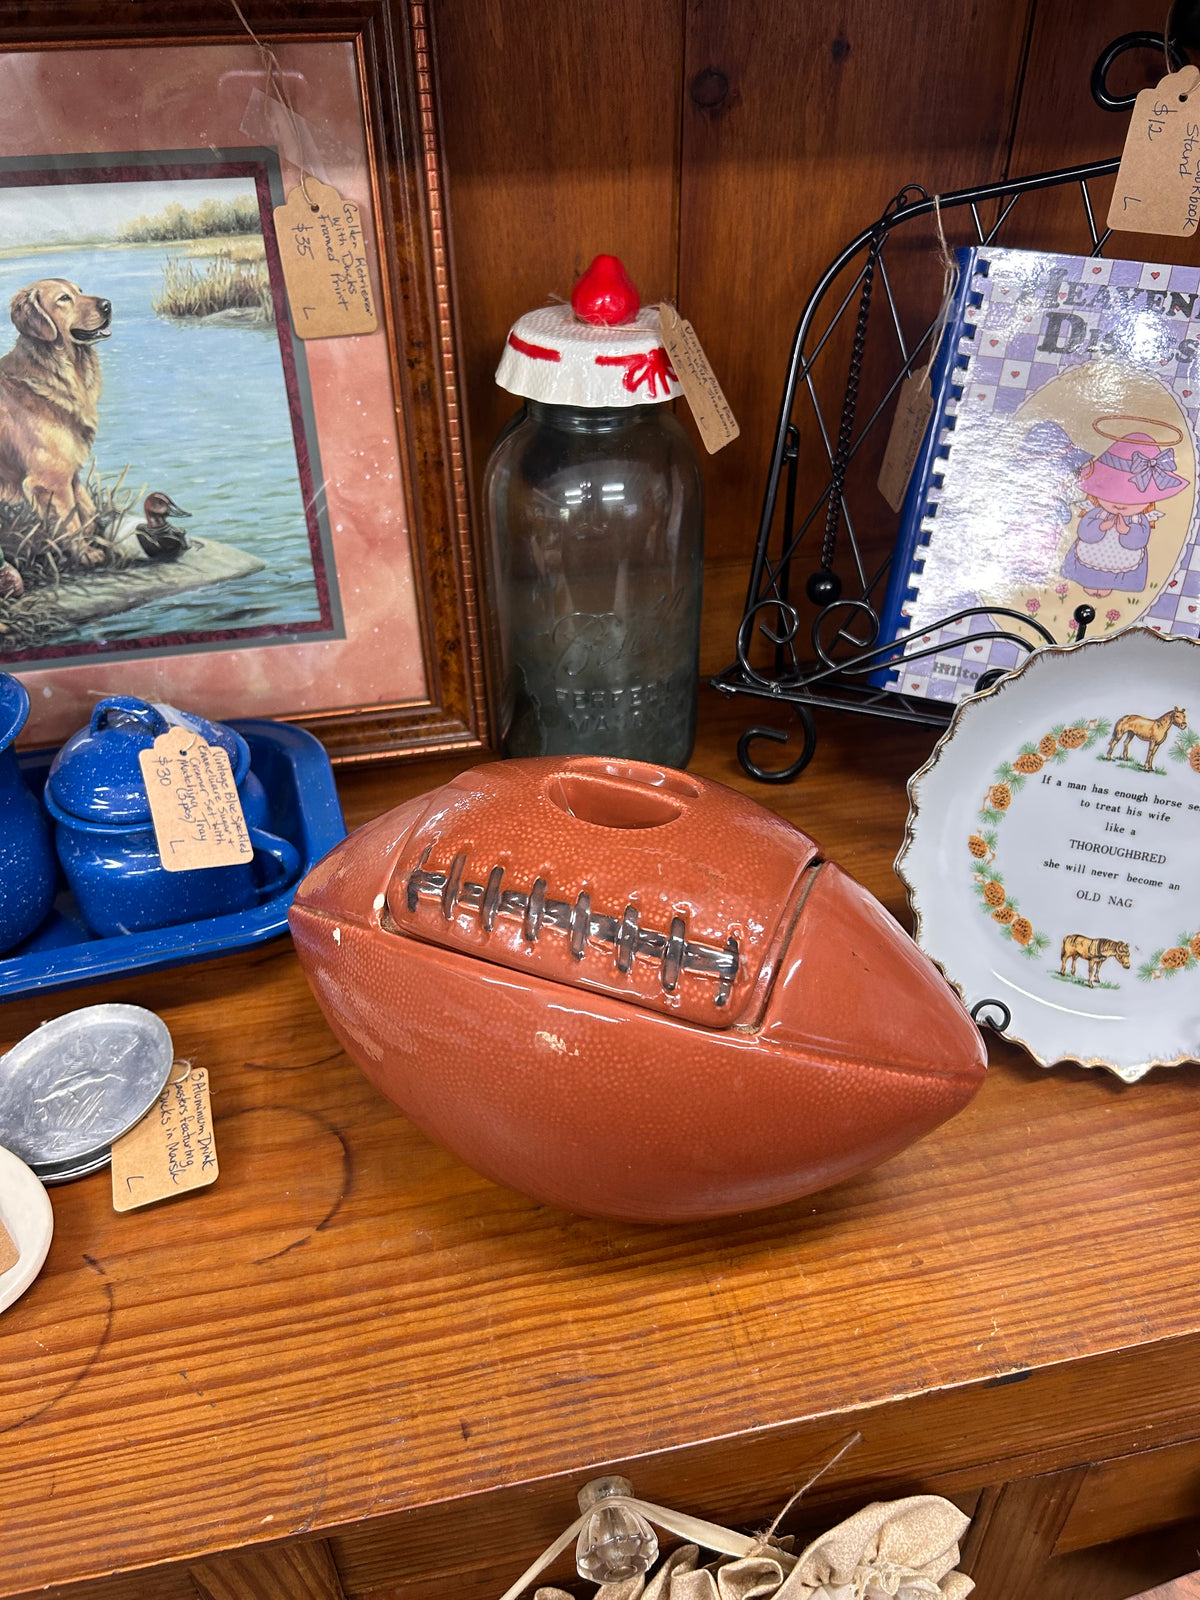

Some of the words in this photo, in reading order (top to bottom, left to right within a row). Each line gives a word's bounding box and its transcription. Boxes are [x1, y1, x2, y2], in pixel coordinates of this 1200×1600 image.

[1148, 101, 1178, 141] $12
[1179, 123, 1199, 179] Stand
[291, 223, 314, 260] $35
[318, 214, 340, 263] Framed
[330, 273, 349, 311] Print
[342, 251, 357, 295] Ducks
[343, 203, 362, 249] Golden
[355, 257, 373, 317] Retriever
[1018, 267, 1200, 319] EAVEN
[302, 306, 316, 320] L
[932, 660, 977, 680] Hillto
[152, 755, 173, 787] $30
[213, 750, 230, 790] Vintage
[190, 757, 210, 797] Creamer
[204, 799, 217, 820] Set
[225, 791, 238, 814] Blue
[1041, 774, 1052, 785] If
[1056, 779, 1062, 787] a
[1067, 782, 1087, 791] man
[1091, 784, 1109, 795] has
[1114, 789, 1148, 803] enough
[1153, 794, 1183, 808] horse
[1187, 803, 1200, 812] se
[192, 812, 211, 841] Tray
[217, 807, 232, 834] Sugar
[1080, 799, 1090, 808] to
[1096, 801, 1121, 813] treat
[1126, 805, 1142, 817] his
[1148, 811, 1171, 822] wife
[170, 839, 185, 854] L
[231, 815, 252, 853] Speckled
[1105, 822, 1125, 834] like
[1130, 828, 1136, 836] a
[1069, 838, 1167, 865] THOROUGHBRED
[1043, 858, 1060, 869] she
[1065, 863, 1086, 874] will
[1091, 867, 1119, 880] never
[1126, 873, 1163, 888] become
[1168, 882, 1181, 891] an
[1076, 889, 1101, 902] OLD
[1107, 895, 1133, 908] NAG
[191, 1071, 205, 1081] 3
[160, 1089, 176, 1126] Ducks
[166, 1127, 176, 1140] in
[166, 1141, 187, 1185] Marsh
[197, 1131, 216, 1172] Drink
